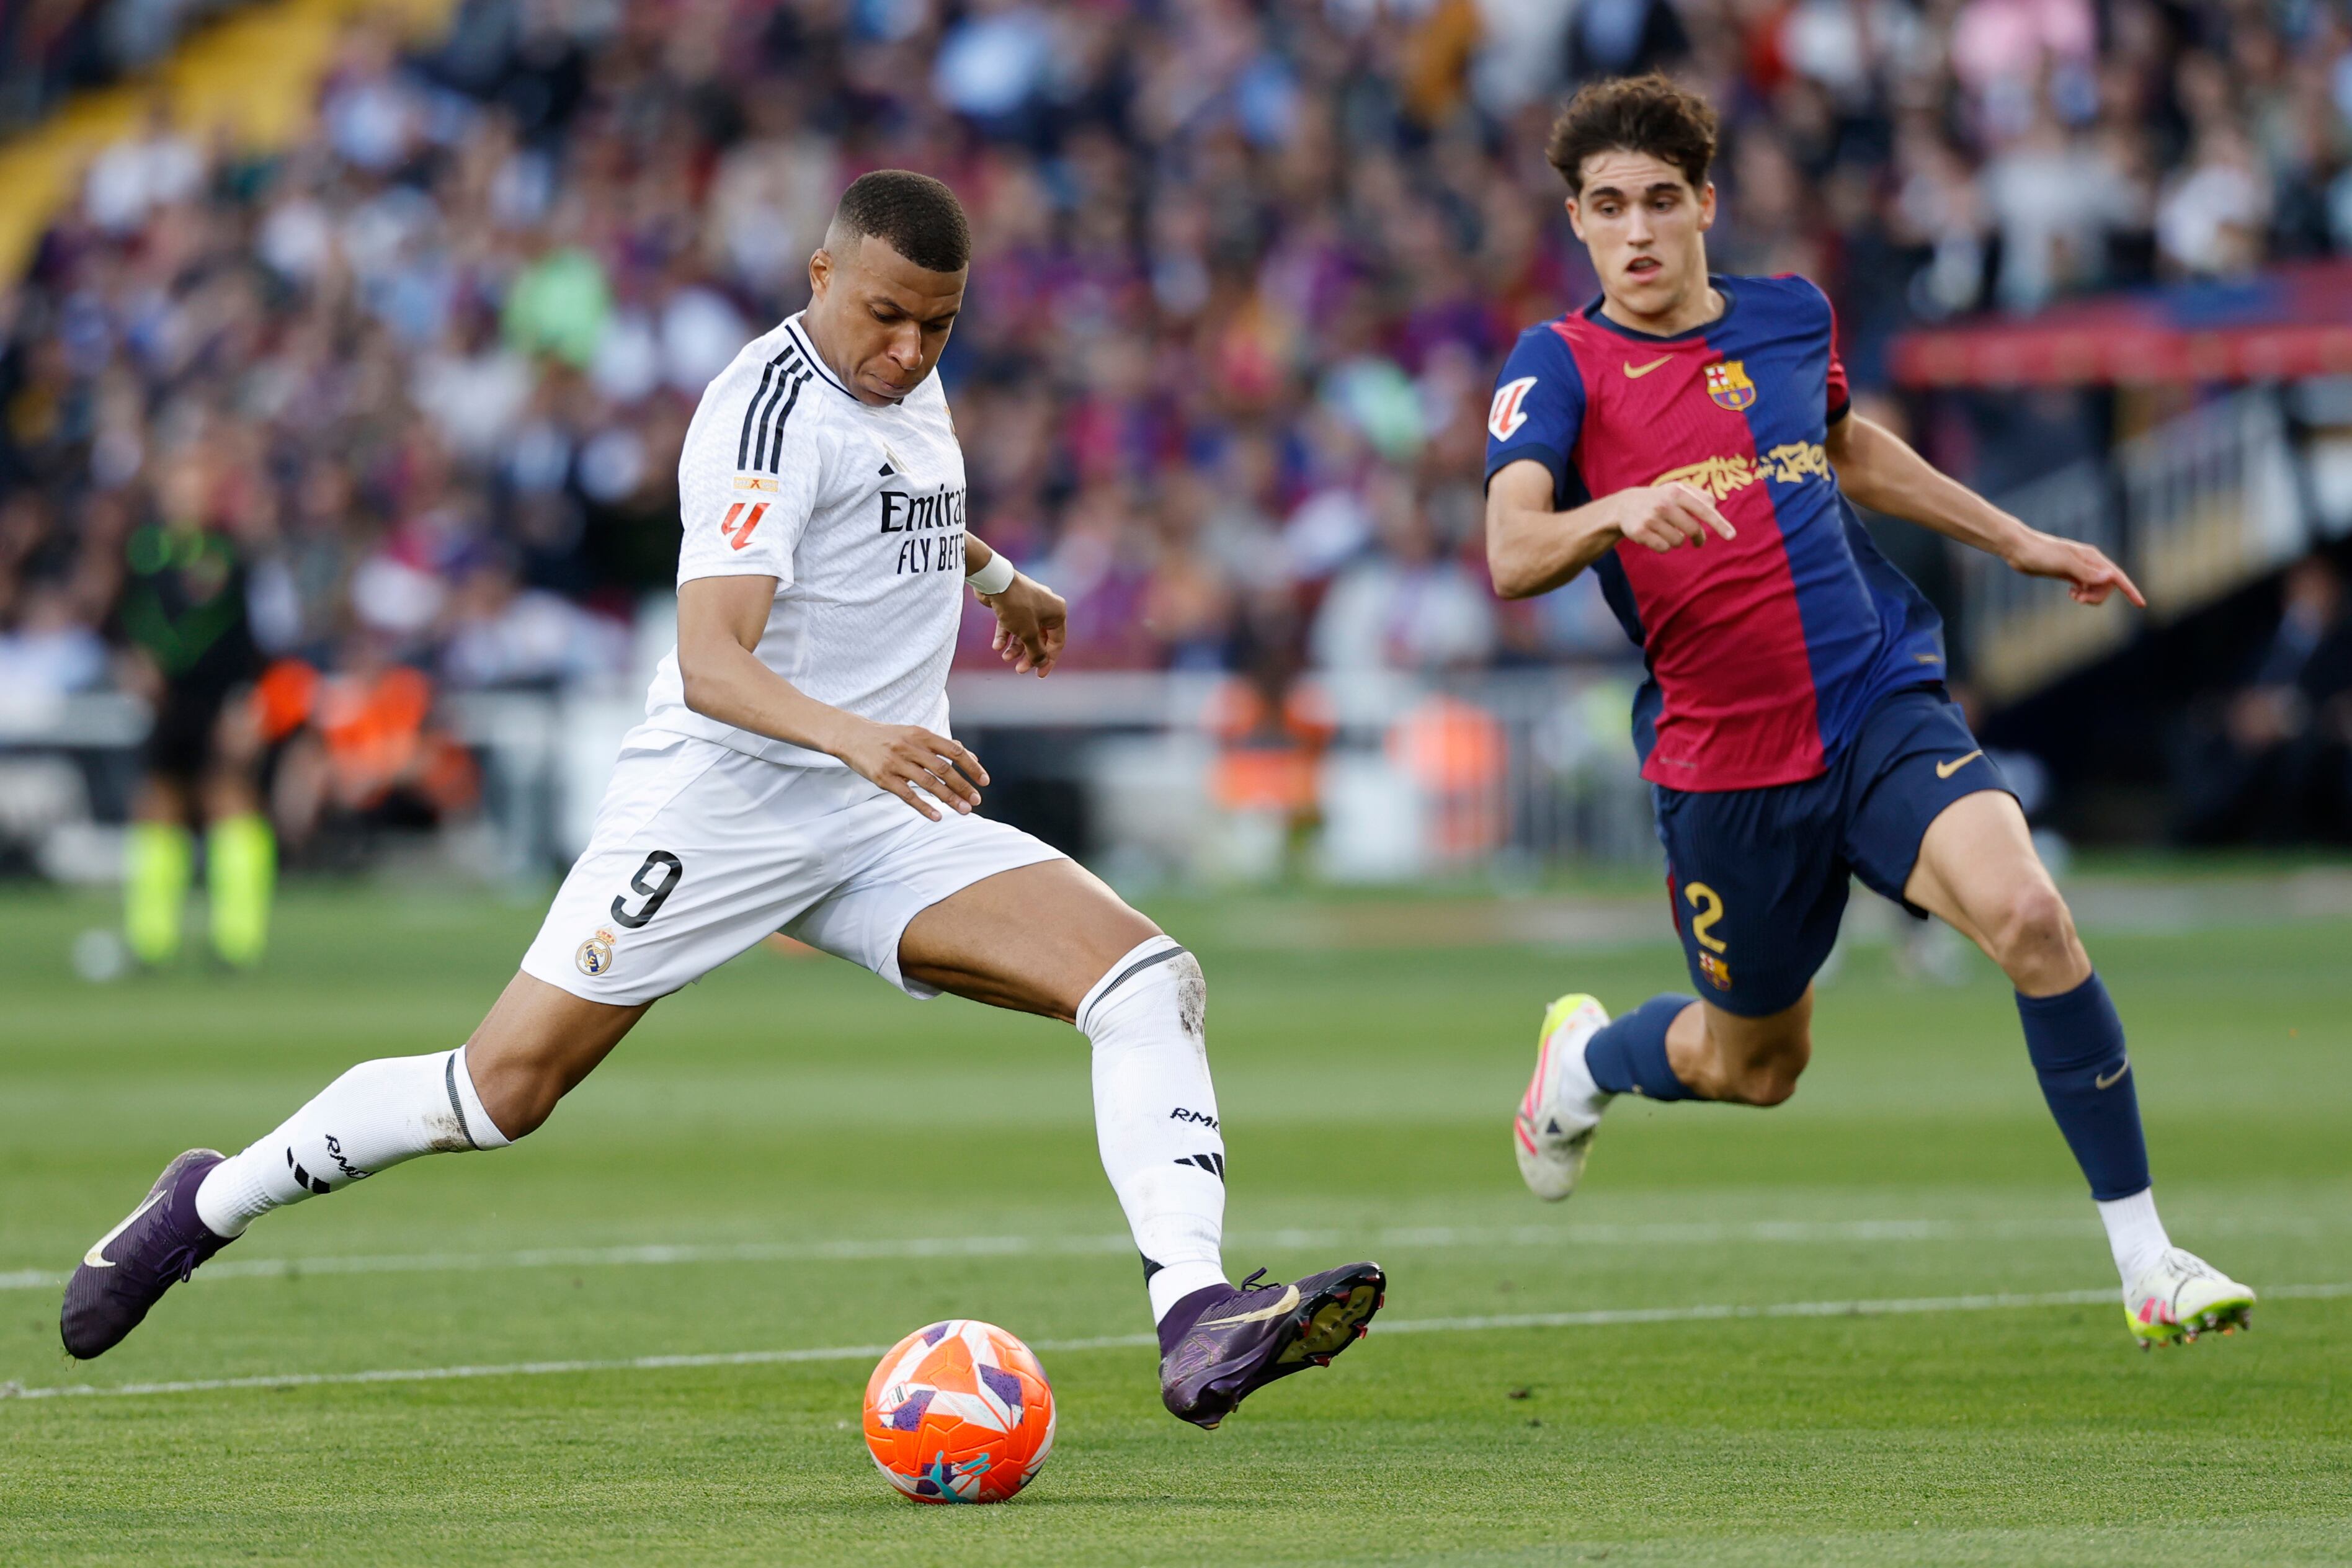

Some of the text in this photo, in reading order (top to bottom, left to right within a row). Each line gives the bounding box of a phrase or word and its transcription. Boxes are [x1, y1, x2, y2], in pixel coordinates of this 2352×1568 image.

[897, 538, 931, 574] FLY
[611, 850, 683, 929] 9
[1684, 881, 1727, 954] 2
